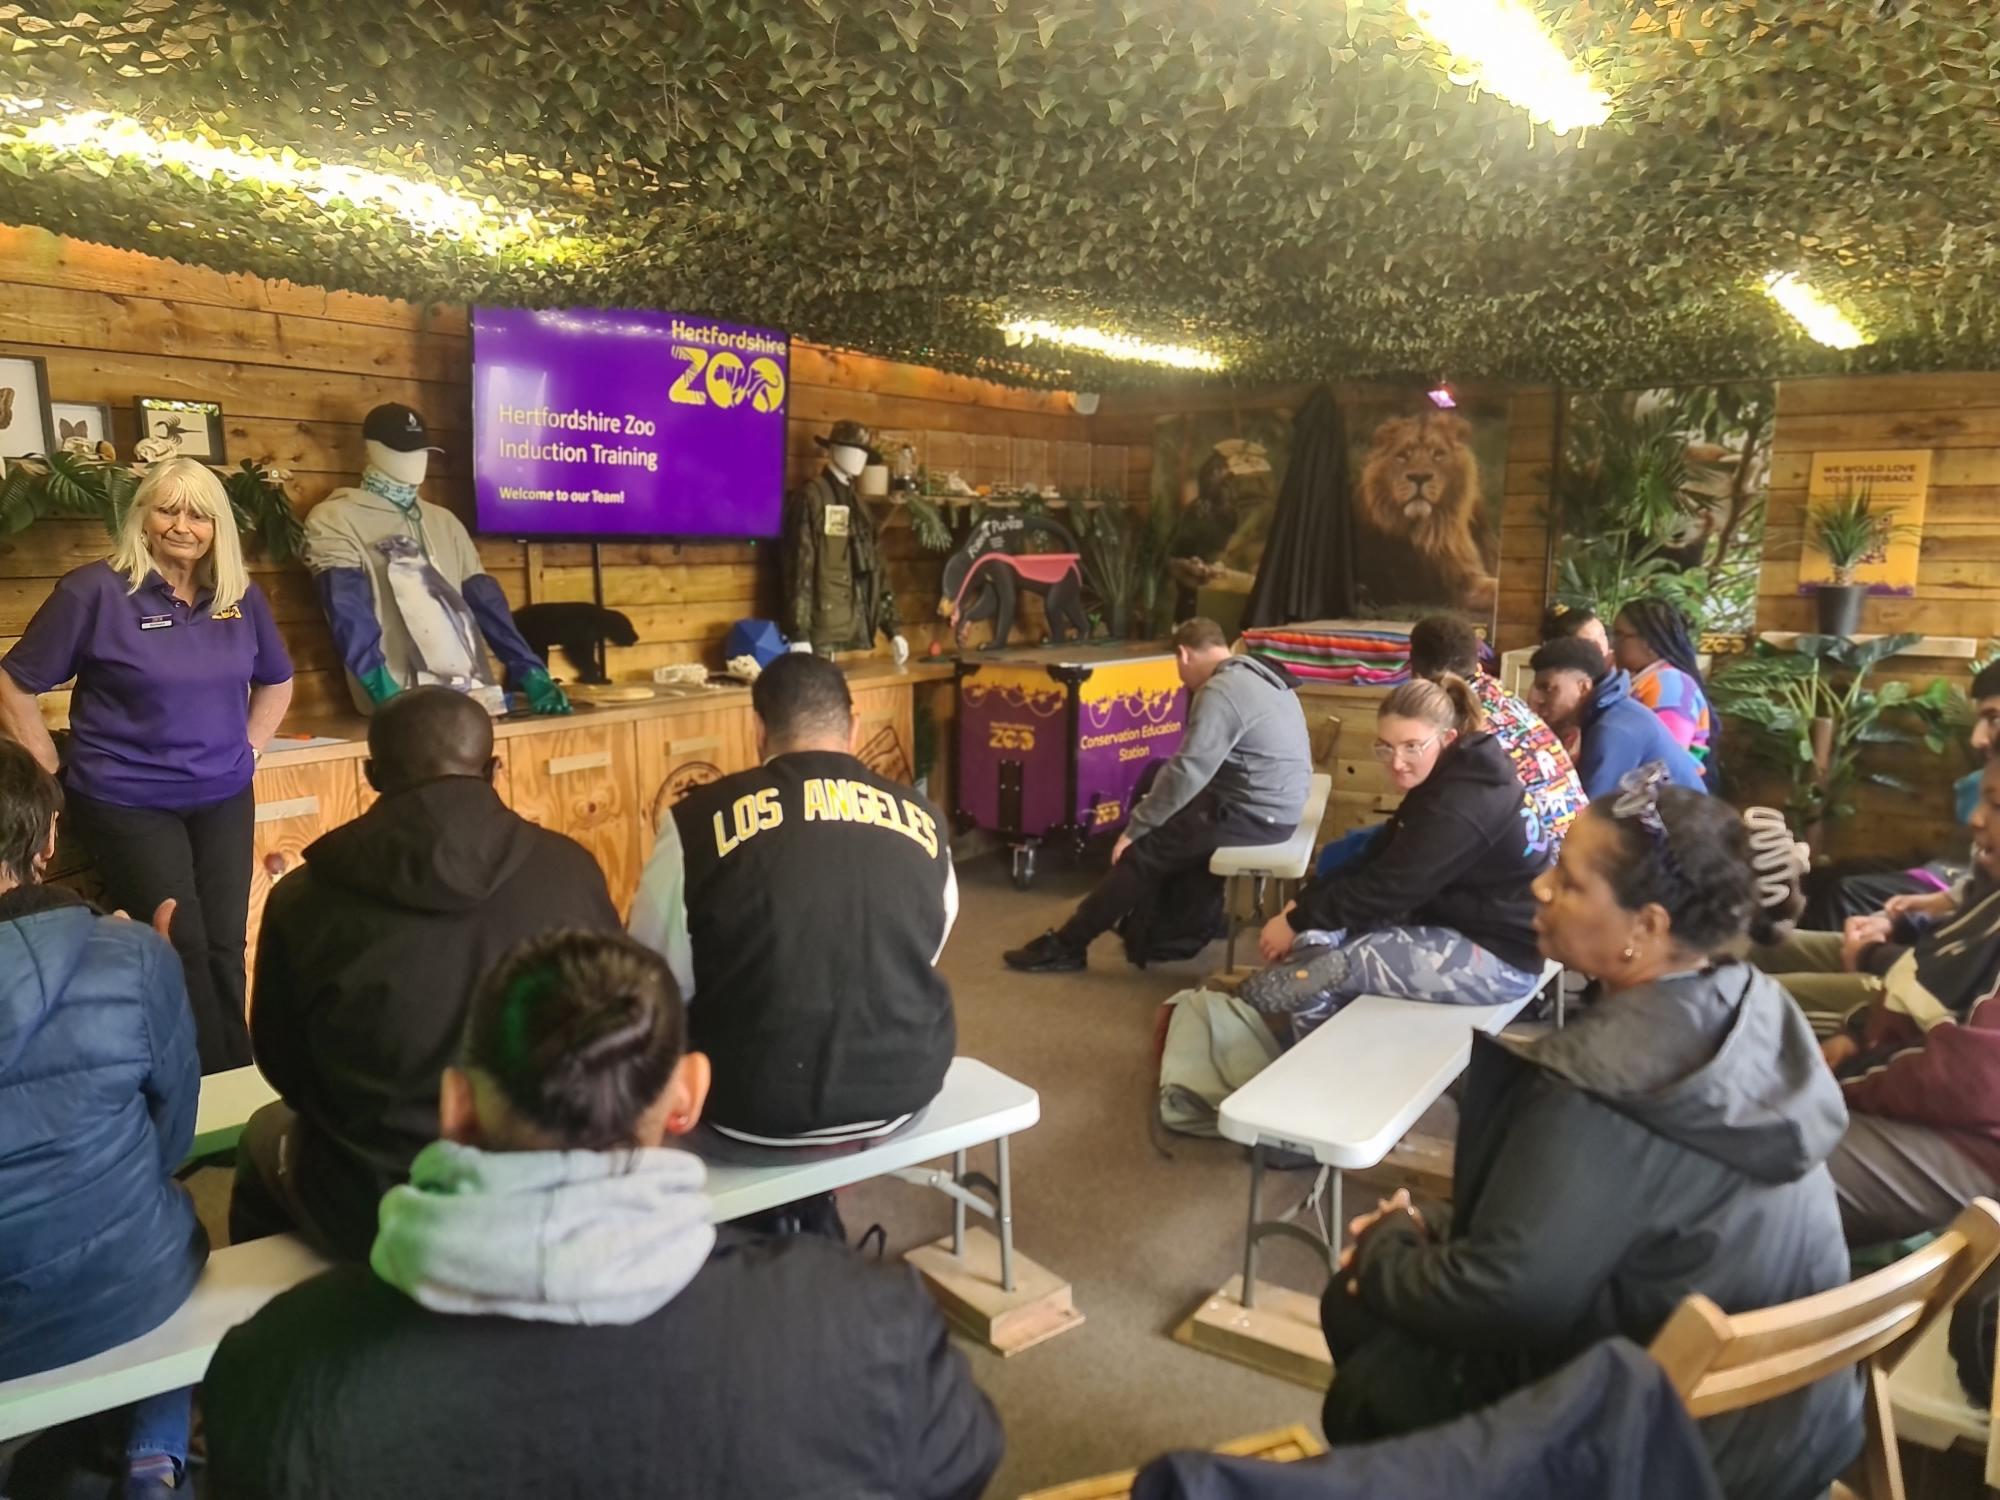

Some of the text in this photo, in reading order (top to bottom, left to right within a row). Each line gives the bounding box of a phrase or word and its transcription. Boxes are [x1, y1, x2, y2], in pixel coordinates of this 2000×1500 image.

[671, 319, 787, 356] Hertfordshire
[499, 404, 656, 436] Hertfordshire Zoo
[500, 438, 658, 472] Induction Training
[1824, 464, 1917, 473] WE WOULD LOVE
[1855, 473, 1915, 482] FEEDBACK
[499, 486, 625, 504] Welcome to our Team!
[1080, 721, 1181, 750] Conservation Education
[1119, 745, 1150, 762] Station
[713, 778, 939, 860] LOS ANGELES
